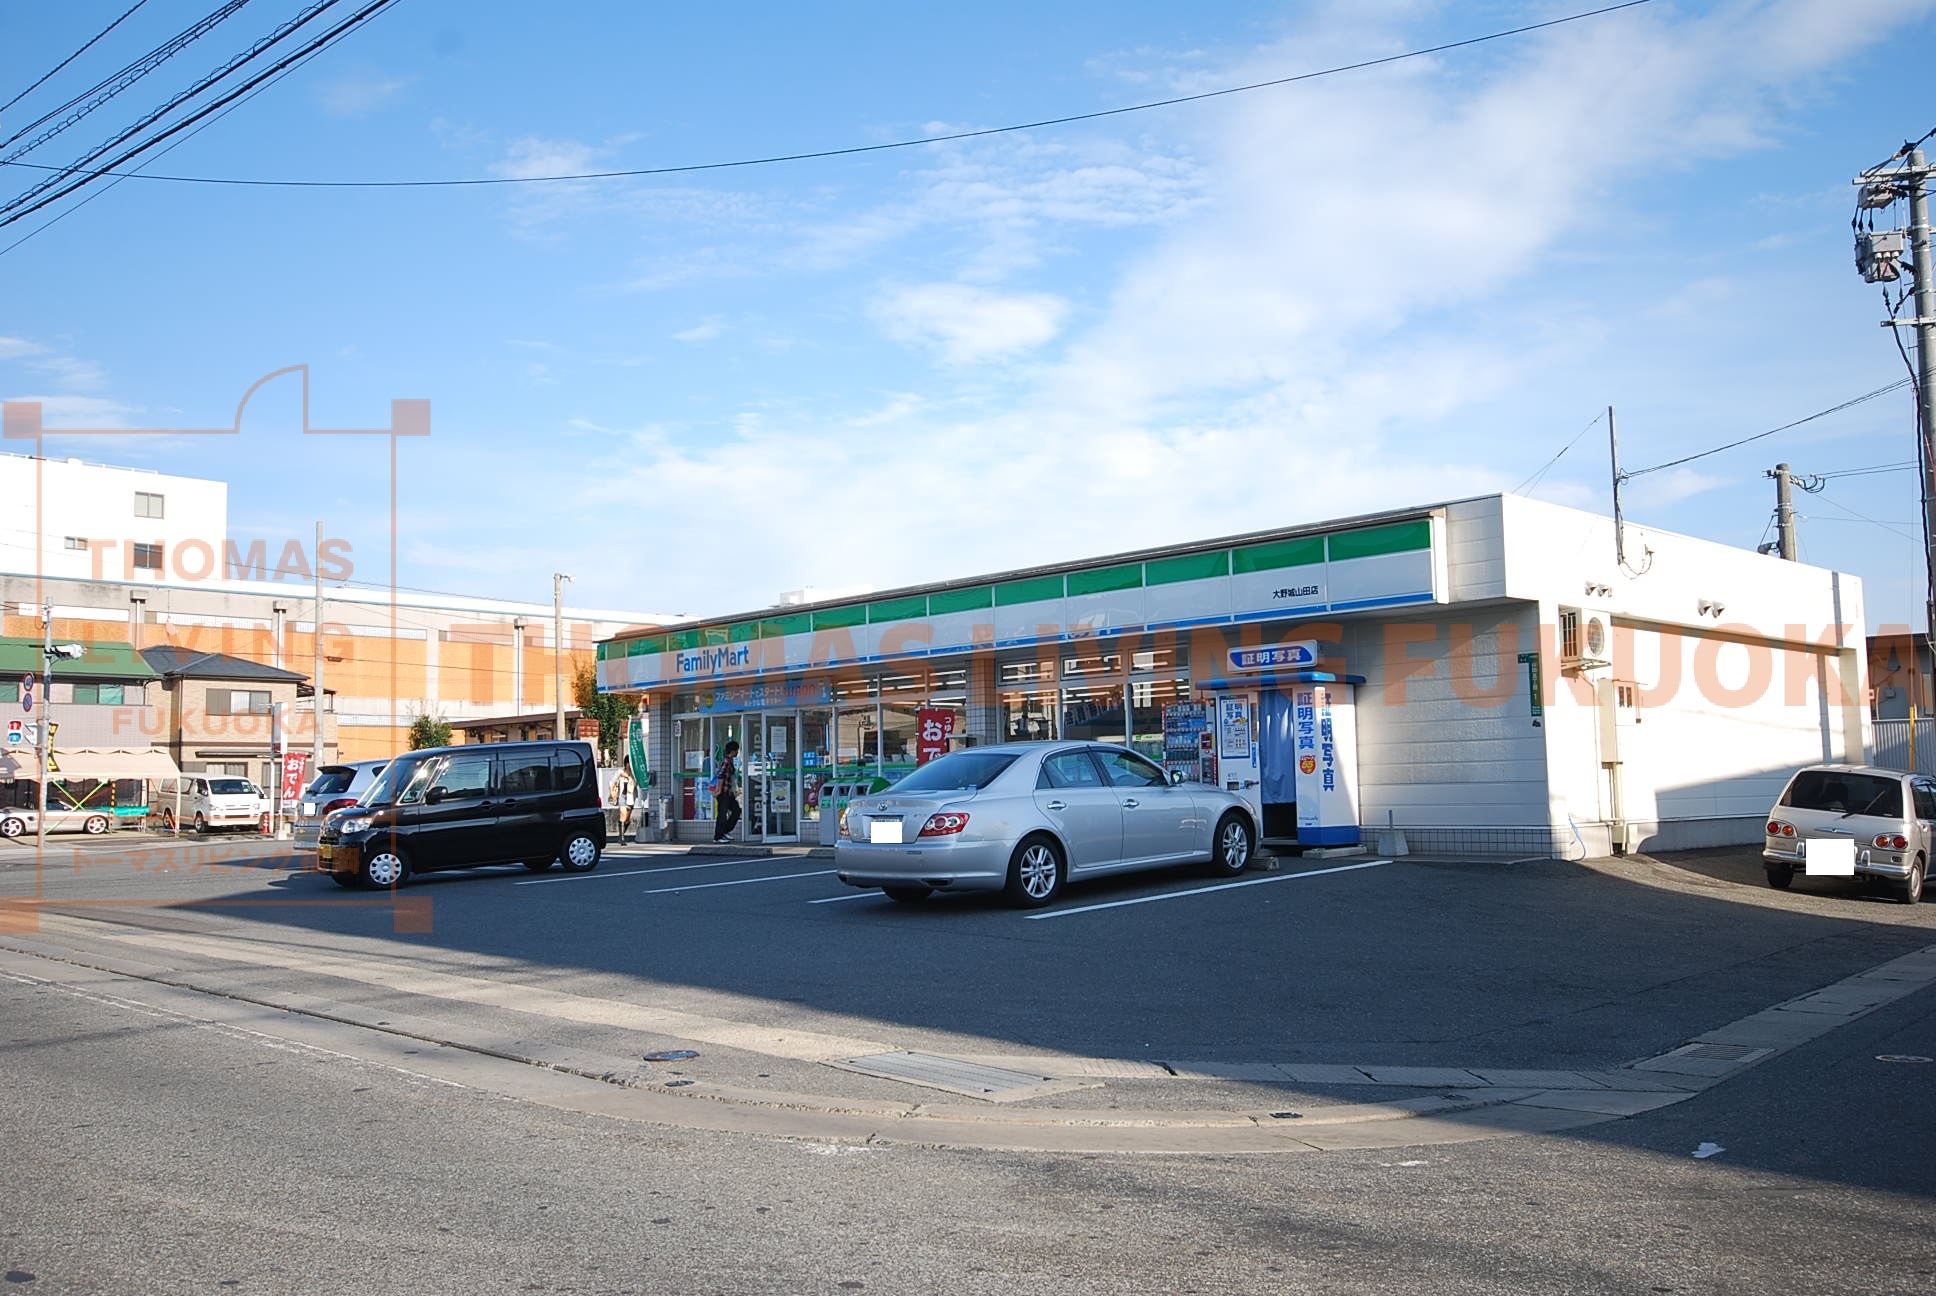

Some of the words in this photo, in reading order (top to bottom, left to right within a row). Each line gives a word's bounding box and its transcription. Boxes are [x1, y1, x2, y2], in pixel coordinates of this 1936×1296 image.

[1273, 585, 1319, 599] 大野城山田店
[676, 645, 750, 674] FamilyMart
[1241, 648, 1302, 666] 証明写真
[1297, 692, 1315, 750] 証明写真
[284, 758, 300, 799] おでん
